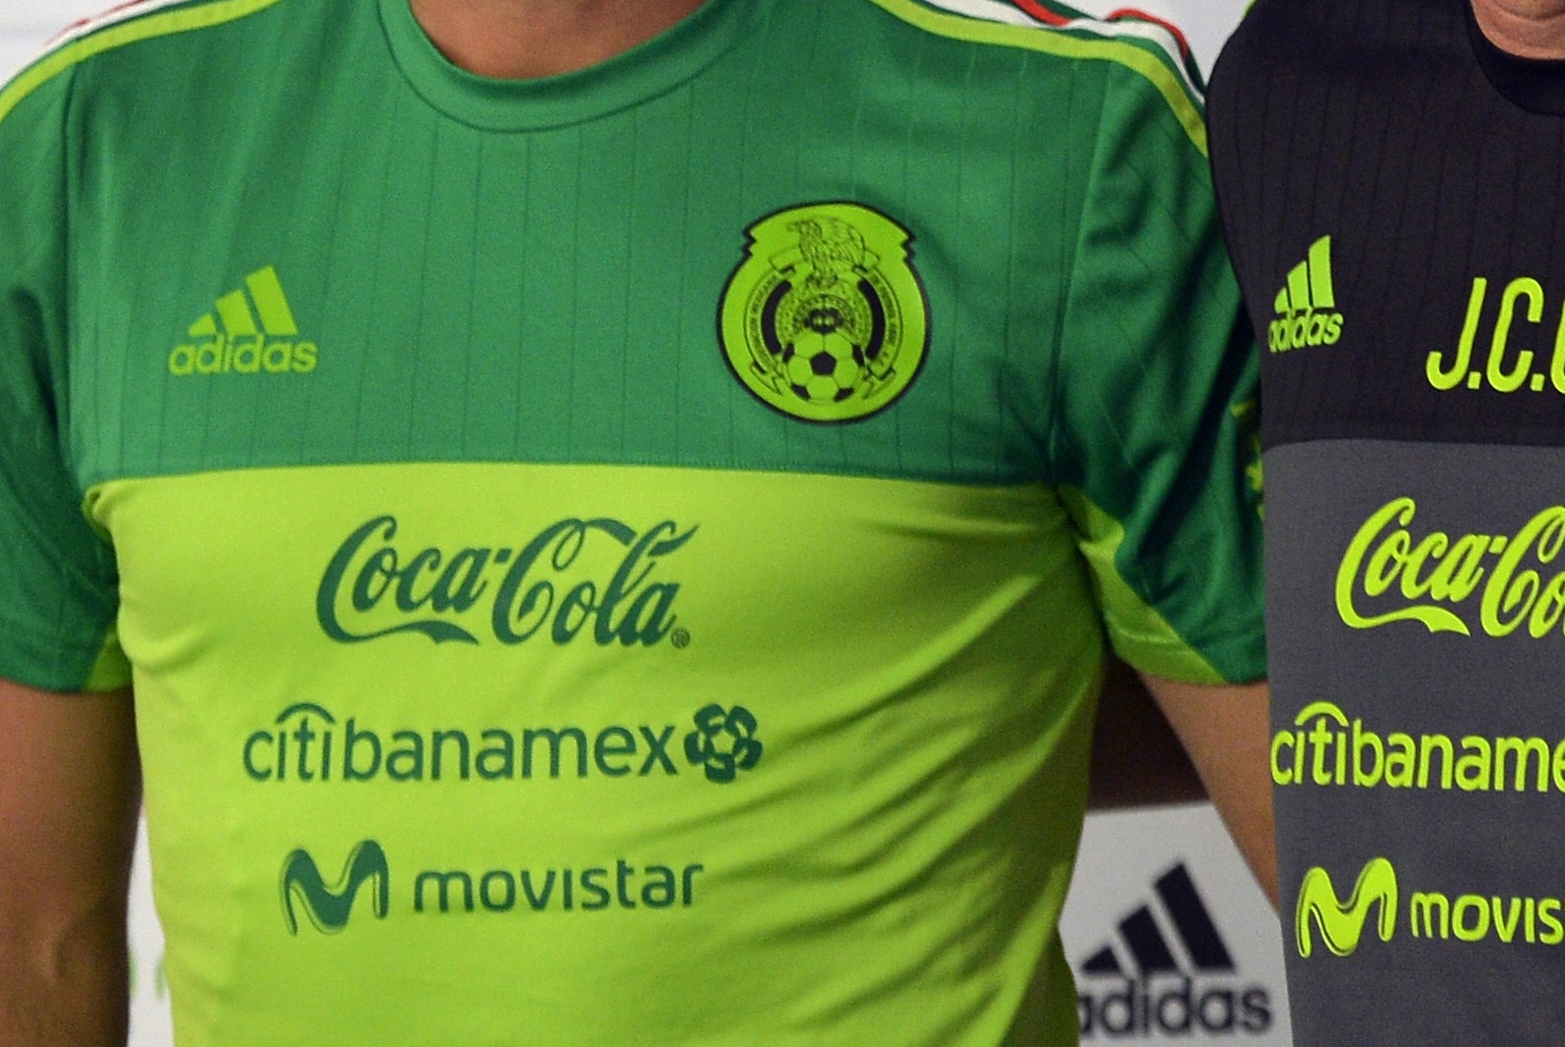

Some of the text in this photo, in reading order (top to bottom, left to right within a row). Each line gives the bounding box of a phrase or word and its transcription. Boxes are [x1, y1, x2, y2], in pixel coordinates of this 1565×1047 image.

[169, 334, 318, 377] adidas
[1268, 305, 1345, 354] adidas
[317, 515, 700, 648] Coca-Cola
[243, 710, 680, 782] citibanamex
[413, 858, 704, 913] movistar
